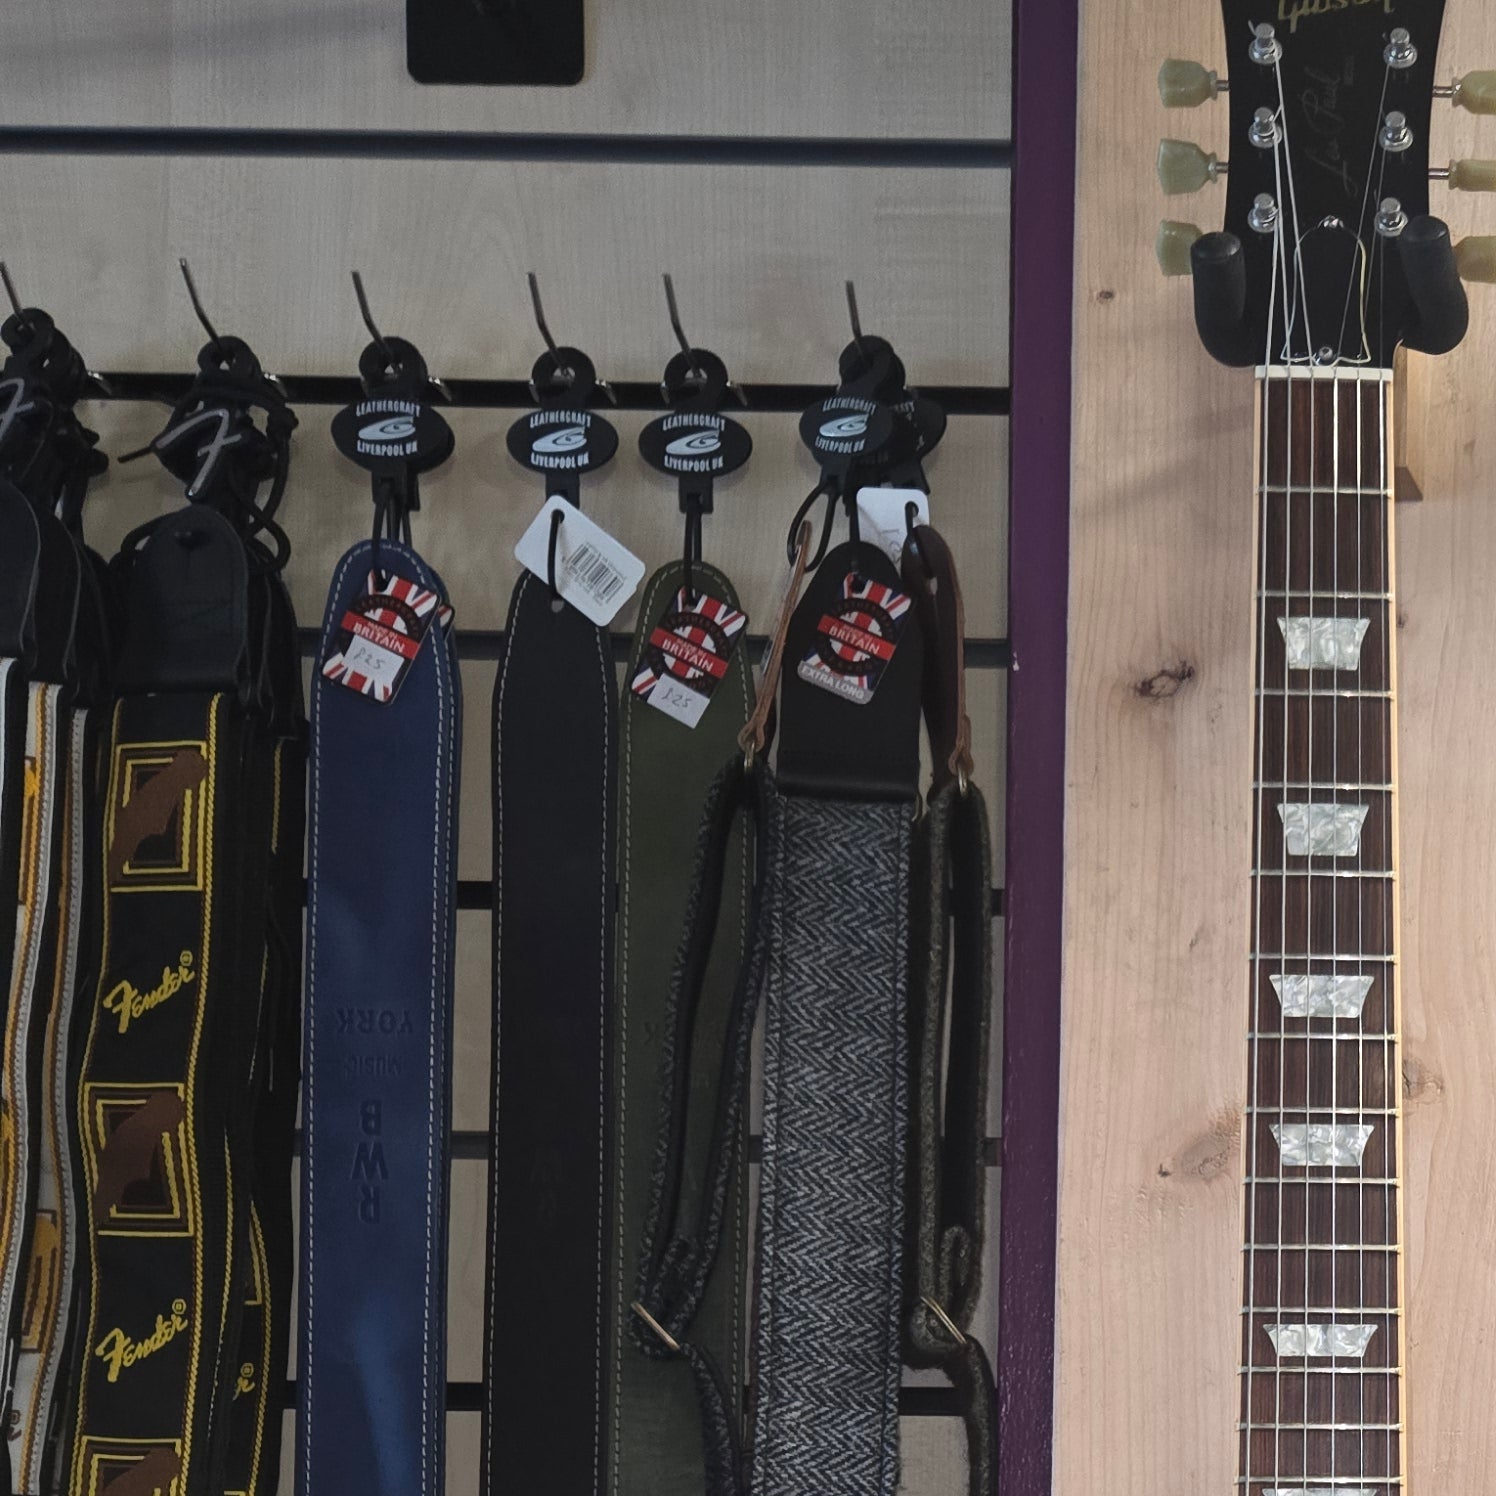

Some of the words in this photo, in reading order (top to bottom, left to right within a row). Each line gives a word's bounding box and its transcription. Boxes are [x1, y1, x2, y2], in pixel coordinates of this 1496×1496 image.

[356, 400, 420, 417] LEATHERCRAFT
[357, 440, 404, 456] LIVERPOOL
[530, 452, 576, 469] LIVERPOOL
[664, 455, 710, 472] LIVERPOOL
[352, 622, 406, 653] BRITAIN
[828, 625, 880, 655] BRITAIN
[661, 639, 714, 673] BRITAIN
[800, 664, 834, 687] EXTRA
[835, 680, 866, 701] LONG
[103, 965, 195, 1034] Fender
[336, 1007, 414, 1034] YORK
[95, 1313, 189, 1383] Fender
